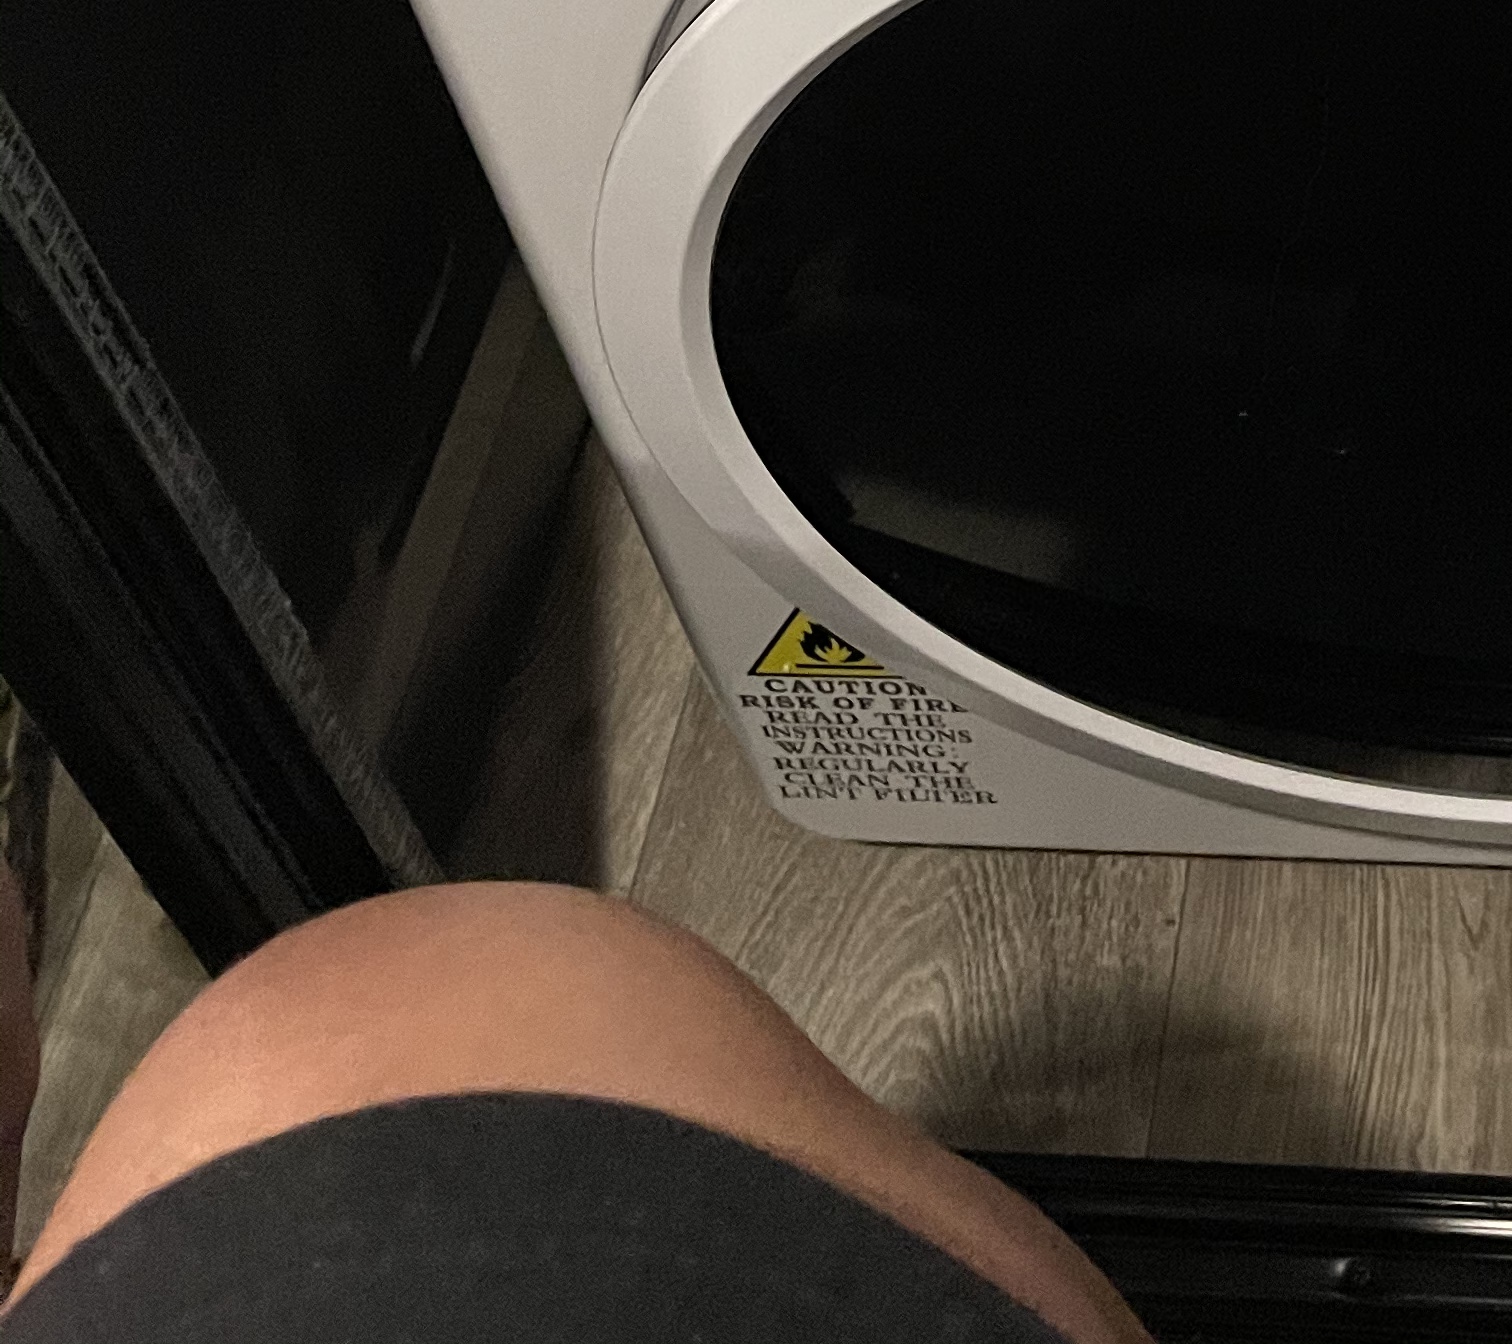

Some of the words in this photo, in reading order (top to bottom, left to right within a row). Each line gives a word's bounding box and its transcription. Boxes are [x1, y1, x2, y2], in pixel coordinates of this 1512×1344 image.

[764, 678, 927, 697] CAUTION
[739, 694, 821, 710] RISK
[833, 696, 875, 710] OF
[765, 710, 860, 725] READ
[874, 712, 946, 728] THE
[762, 725, 973, 744] INSTRUCTIONS
[775, 740, 959, 759] WARNING:
[773, 757, 969, 775] REGULARLY
[784, 772, 890, 788] CLEAN
[904, 775, 975, 790] THE
[779, 785, 863, 801] LINT
[875, 787, 998, 805] FILTER
